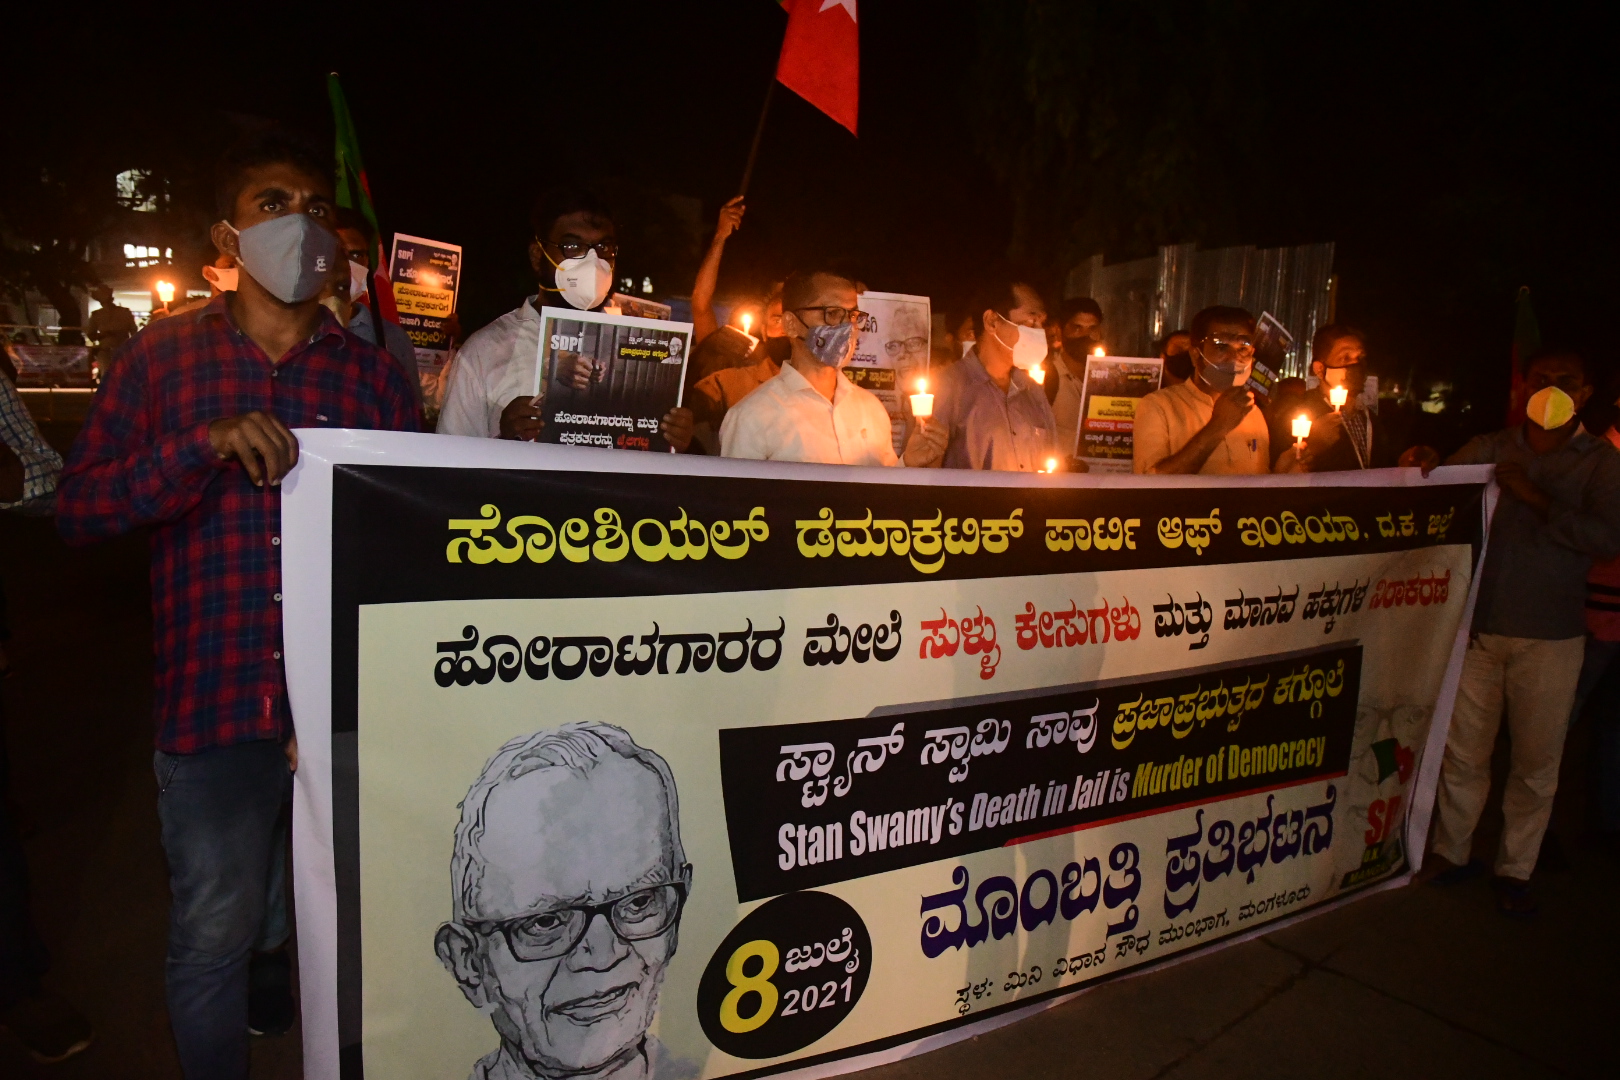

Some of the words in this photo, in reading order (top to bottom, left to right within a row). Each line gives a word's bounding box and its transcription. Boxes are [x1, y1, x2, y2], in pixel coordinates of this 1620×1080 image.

[554, 410, 634, 432] ಹೋರಾಟಗಾರರನ್ನು
[637, 416, 659, 434] ಮತ್ತು
[559, 430, 614, 449] ಪತ್ರಕರ್ತರನ್ನು
[446, 504, 769, 564] ಸೋಶಿಯಲ್
[795, 507, 1024, 574] ಡೆಮಾಕ್ರಟಿಕ್
[1045, 515, 1141, 552] ಪಾರ್ಟಿ
[1157, 507, 1223, 556] ಆಫ್
[1237, 508, 1369, 548] ಇಂಡಿಯಾ,
[433, 615, 786, 688] ಹೋರಾಟಗಾರರ
[802, 609, 902, 667] ಮೇಲೆ
[919, 604, 1002, 680] ಸುಳ್ಳು
[1014, 597, 1141, 650] ಕೇಸುಗಳು
[1153, 591, 1213, 651] ಮತ್ತು
[1223, 584, 1299, 630] ಮಾನವ
[1302, 577, 1370, 634] ಹಕ್ಕುಗಳ
[1368, 568, 1452, 610] ನಿರಾಕರಣೆ
[776, 722, 905, 808] ಸ್ಟ್ಯಾನ್
[920, 717, 1012, 783] ಸ್ವಾಮಿ
[1026, 697, 1099, 754] ಸಾವು
[1111, 673, 1270, 750] ಪ್ರಜಾಪ್ರಭುತ್ವದ
[1273, 658, 1345, 718] ಕಗ್ಗೊಲೆ
[778, 821, 843, 871] Stan
[850, 797, 964, 856] Swamy's
[968, 784, 1041, 832] Death
[1042, 779, 1067, 817] in
[1068, 769, 1110, 812] Jail
[1109, 770, 1130, 803] is
[1131, 754, 1202, 799] Murder
[1206, 749, 1226, 783] of
[1228, 736, 1326, 779] Democracy
[920, 841, 1142, 959] ಮೊಂಬತ್ತಿ
[1163, 784, 1337, 921] ಪ್ರತಿಭಟನೆ
[719, 939, 780, 1034] 8
[784, 927, 860, 973] ಜುಲೈ
[780, 976, 853, 1017] 2021
[955, 978, 993, 1015] ಸ್ಥಳ:
[1003, 965, 1042, 993] ಮಿನಿ
[1052, 943, 1107, 978] ವಿಧಾನ
[1114, 930, 1151, 960] ಸೌಧ
[1158, 908, 1230, 946] ಮುಂಭಾಗ,
[1239, 884, 1311, 921] ಮಂಗಳೂರು
